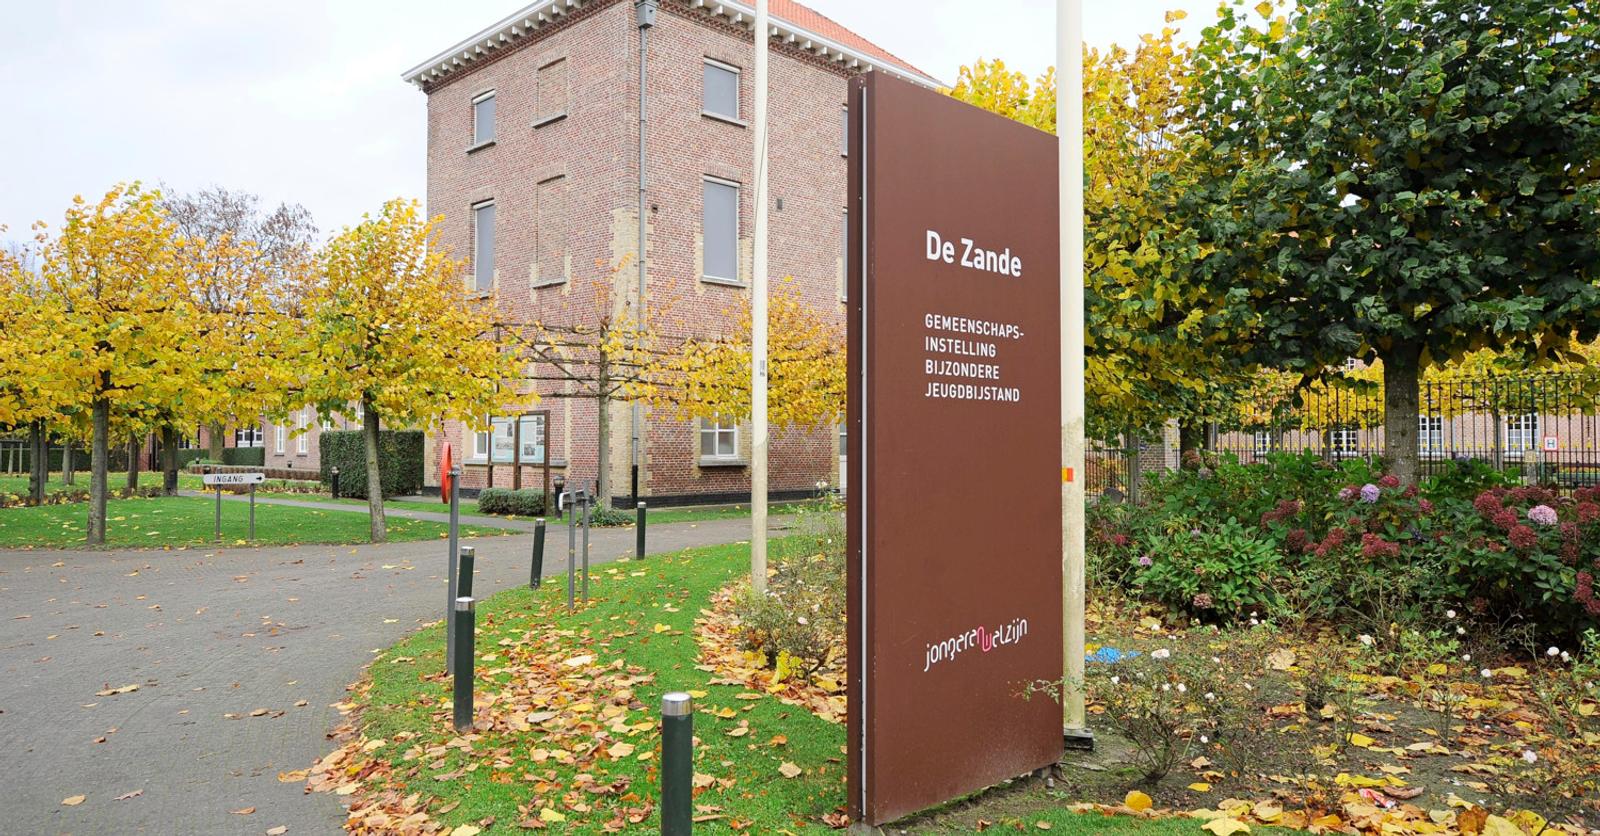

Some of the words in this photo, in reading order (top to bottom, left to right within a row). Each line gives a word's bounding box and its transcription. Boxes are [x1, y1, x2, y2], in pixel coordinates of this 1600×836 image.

[926, 230, 955, 264] De
[961, 238, 1022, 277] Zande
[925, 313, 1025, 339] GEMEENSCHAPS-
[925, 336, 996, 358] INSTELLING
[925, 359, 1000, 380] BIJZONDERE
[925, 382, 1020, 402] JEUGDBIJSTAND
[213, 475, 244, 483] INGANG
